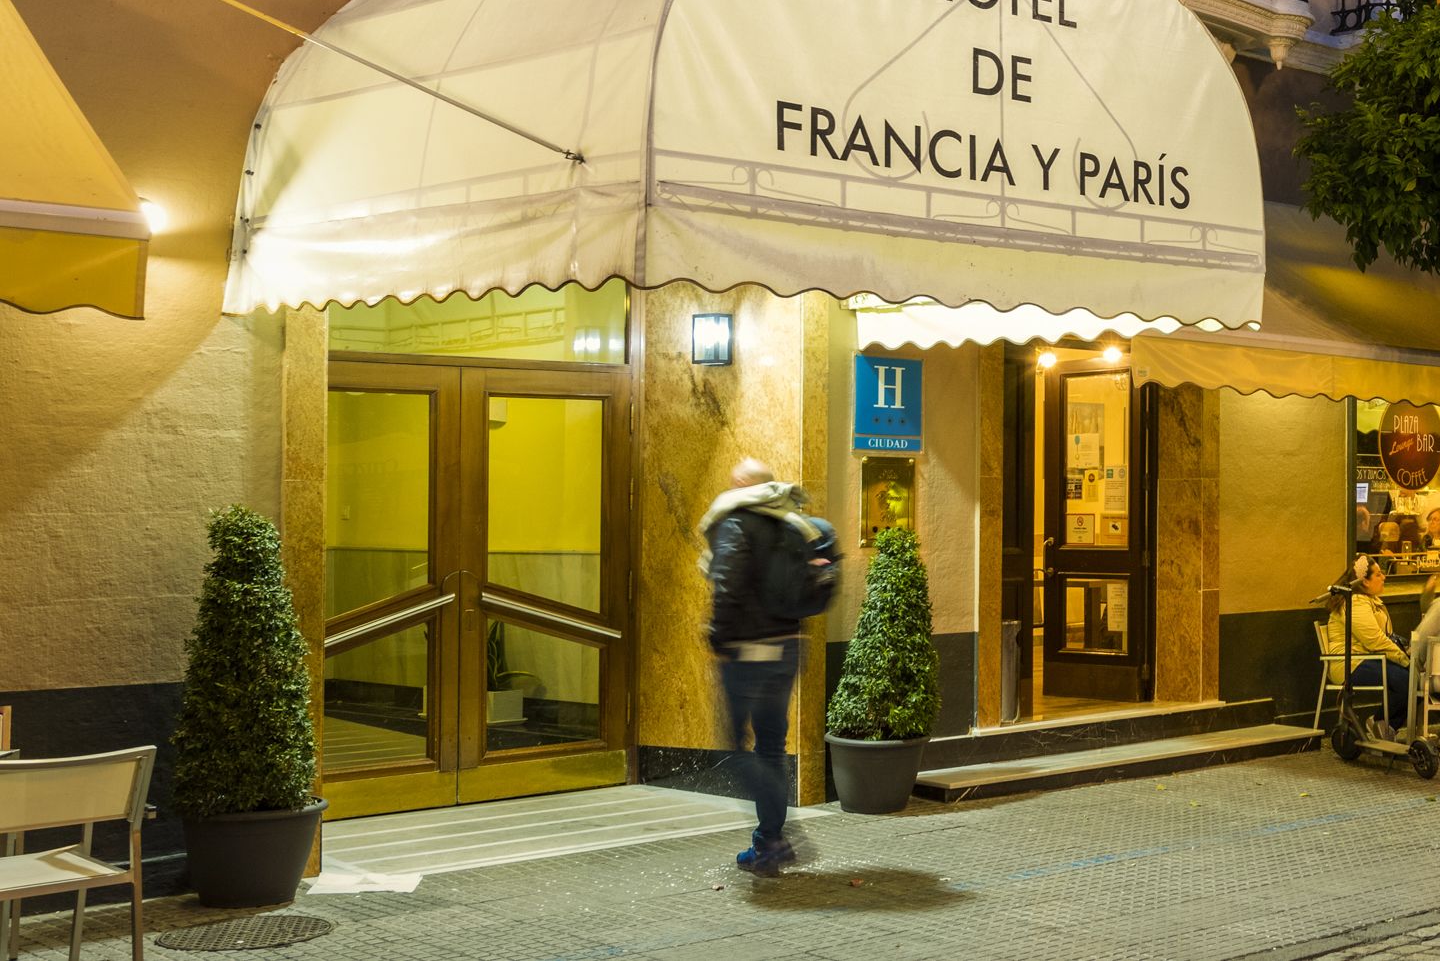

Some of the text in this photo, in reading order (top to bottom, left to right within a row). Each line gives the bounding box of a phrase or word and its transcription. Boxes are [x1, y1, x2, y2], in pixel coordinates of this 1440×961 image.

[972, 47, 1032, 103] DE
[776, 100, 1190, 210] FRANCIA Y PARÍS
[873, 365, 906, 409] H
[1393, 414, 1419, 434] PLAZA
[868, 438, 908, 449] CIUDAD
[1416, 434, 1435, 453] BAR
[1396, 467, 1428, 487] COFFEE
